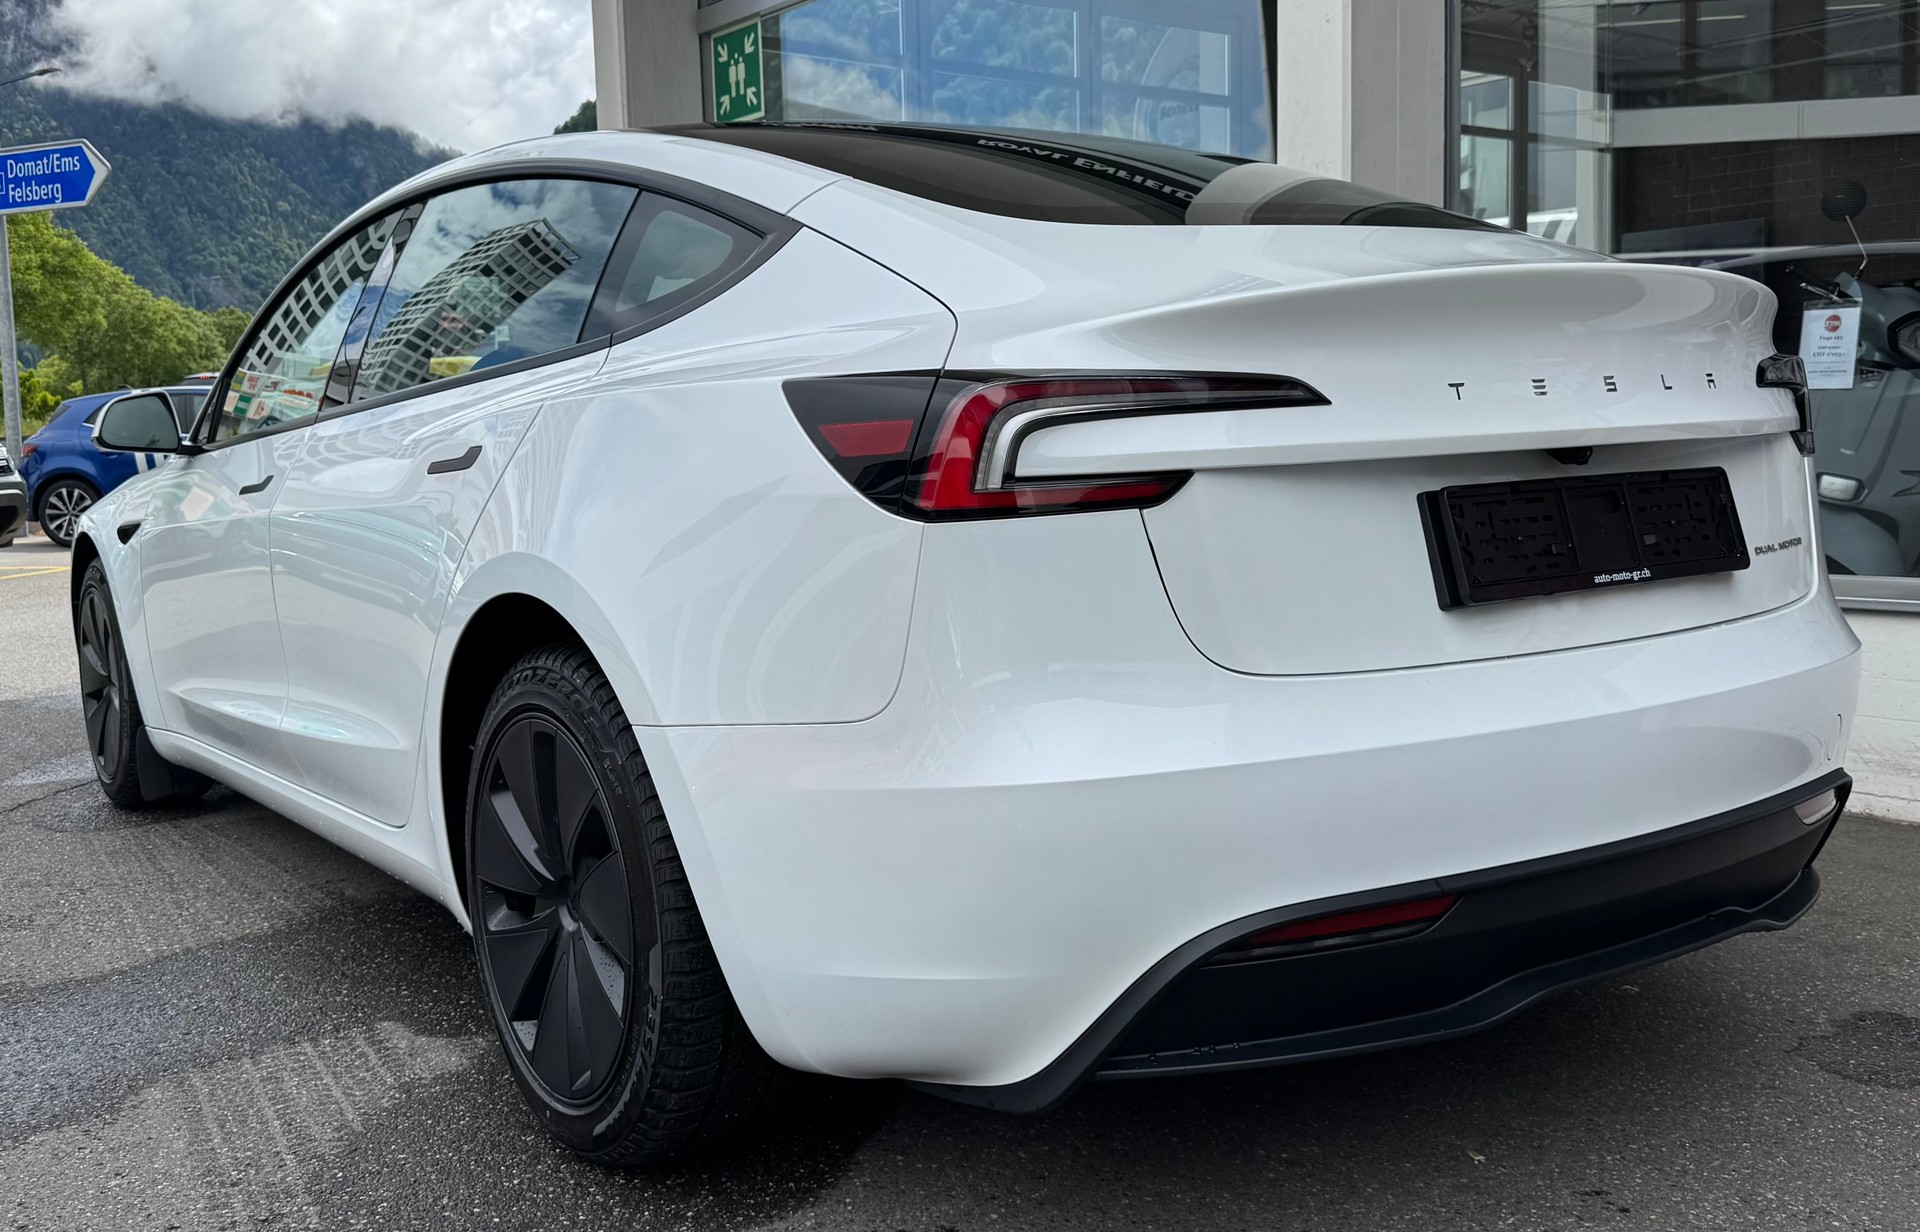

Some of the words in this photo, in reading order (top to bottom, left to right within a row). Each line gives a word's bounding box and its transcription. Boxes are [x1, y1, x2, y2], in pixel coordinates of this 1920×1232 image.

[7, 154, 81, 178] Domat/Ems
[9, 180, 63, 204] Felsberg
[1447, 373, 1717, 401] TESLA
[1754, 543, 1778, 556] DUAL
[1778, 536, 1803, 550] MOTOR
[1593, 567, 1652, 583] auto-moto-gr.ch
